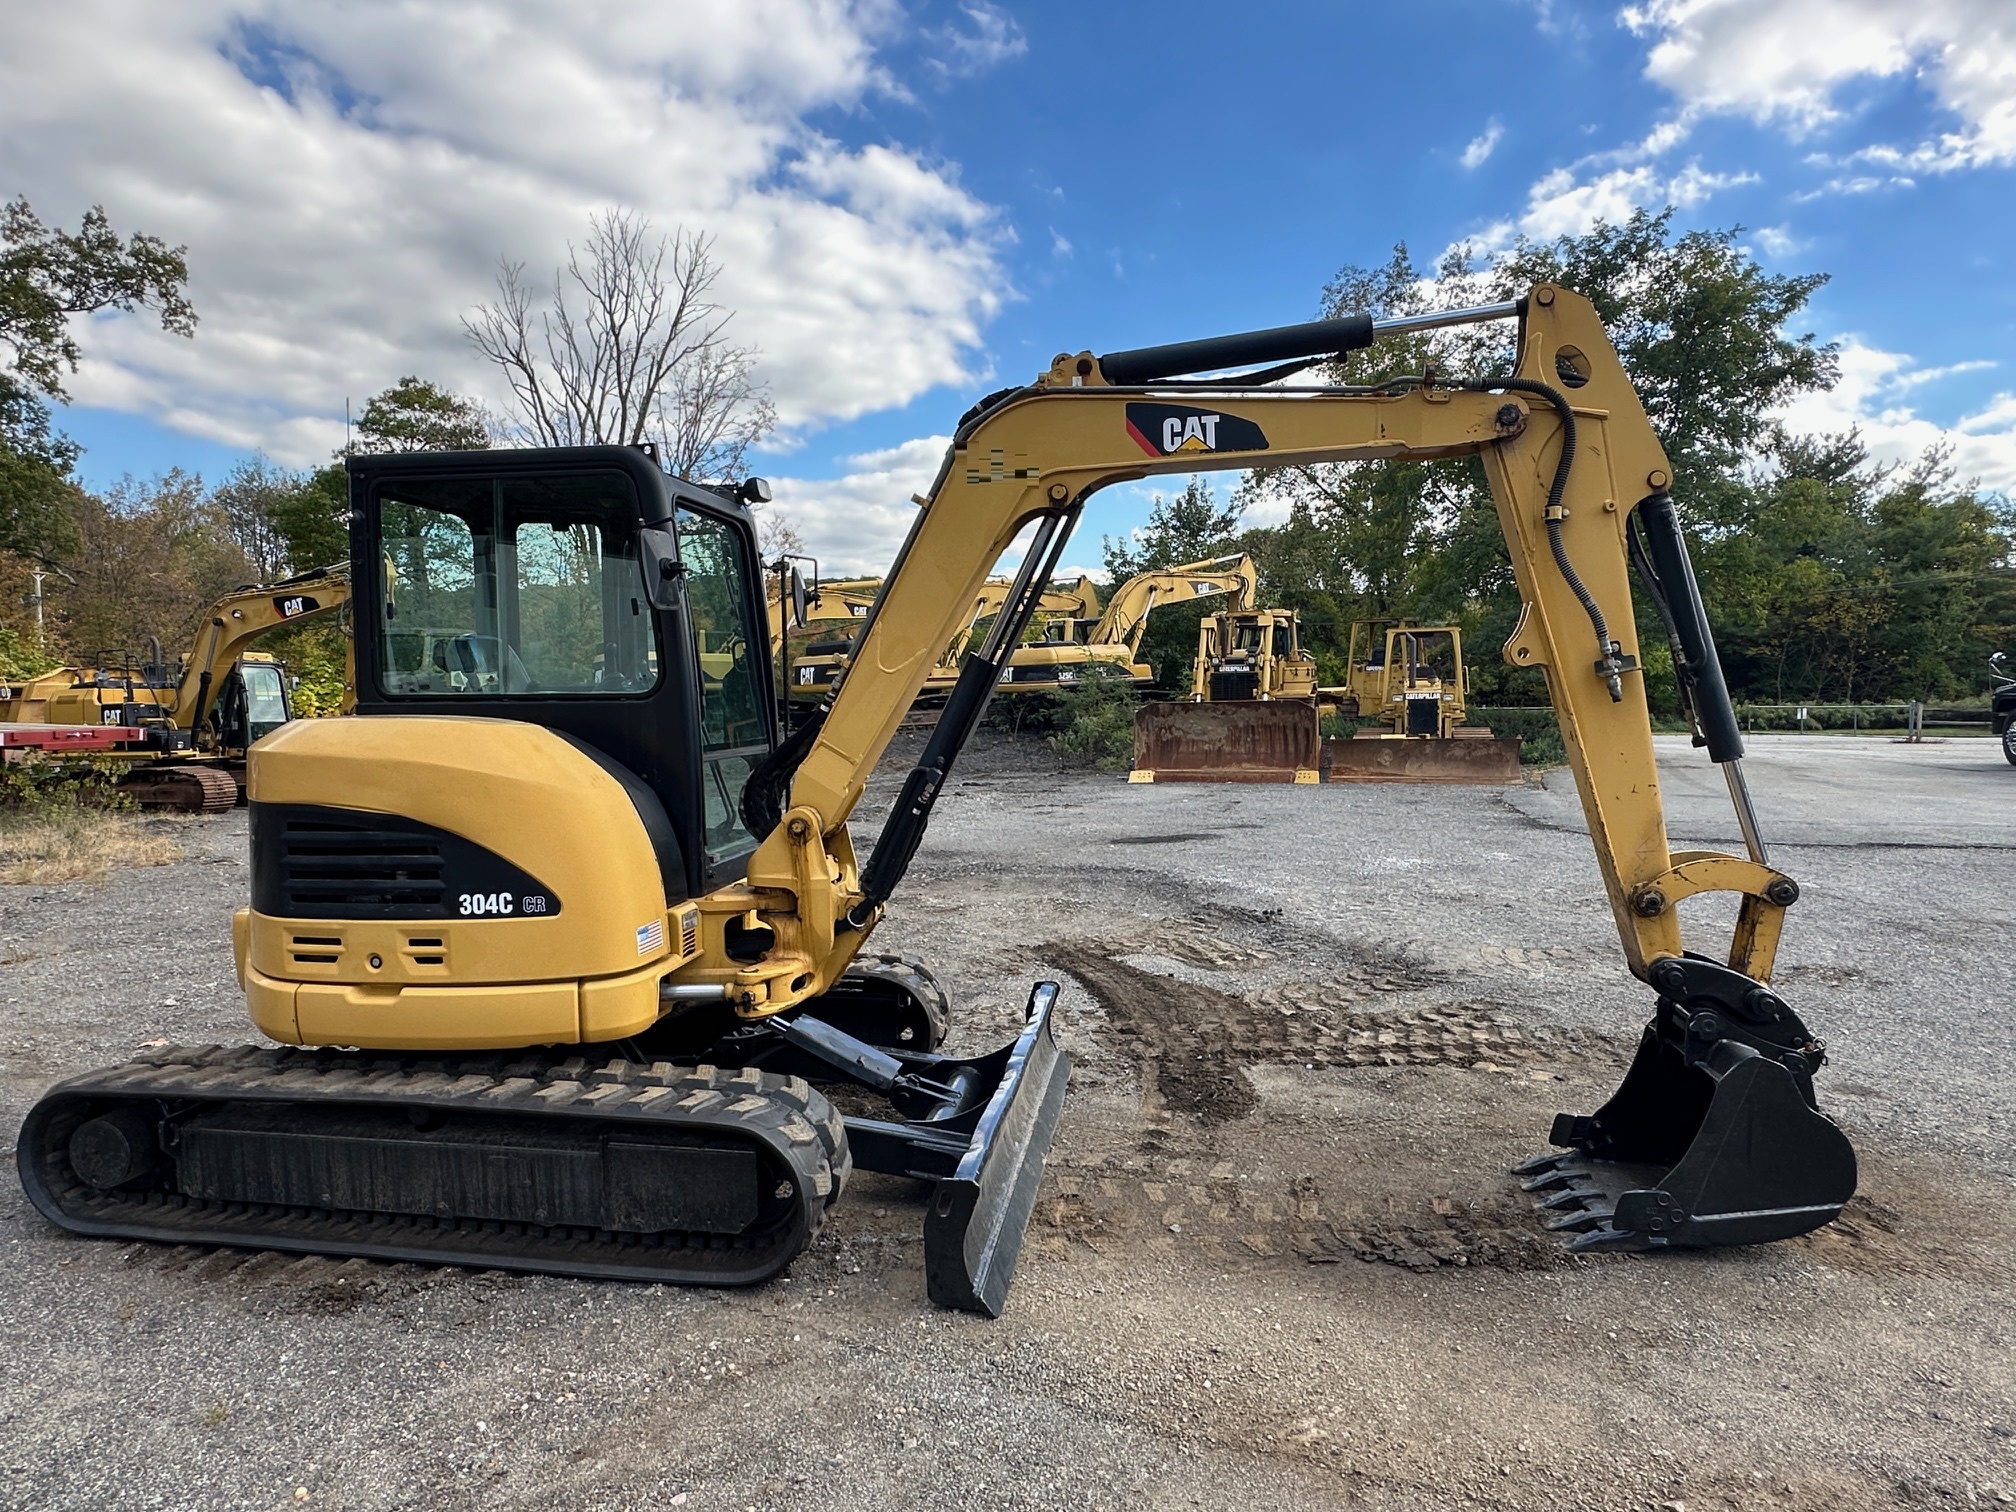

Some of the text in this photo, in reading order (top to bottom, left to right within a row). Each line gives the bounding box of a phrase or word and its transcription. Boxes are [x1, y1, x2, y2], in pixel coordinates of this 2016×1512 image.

[1163, 414, 1220, 453] CAT
[284, 597, 304, 617] CAT
[854, 606, 867, 616] CAT
[800, 667, 815, 685] CAT
[1000, 667, 1014, 682] AT
[1405, 692, 1441, 700] CATERPILLAR
[104, 709, 121, 726] CAT
[459, 892, 546, 915] 304C CR
